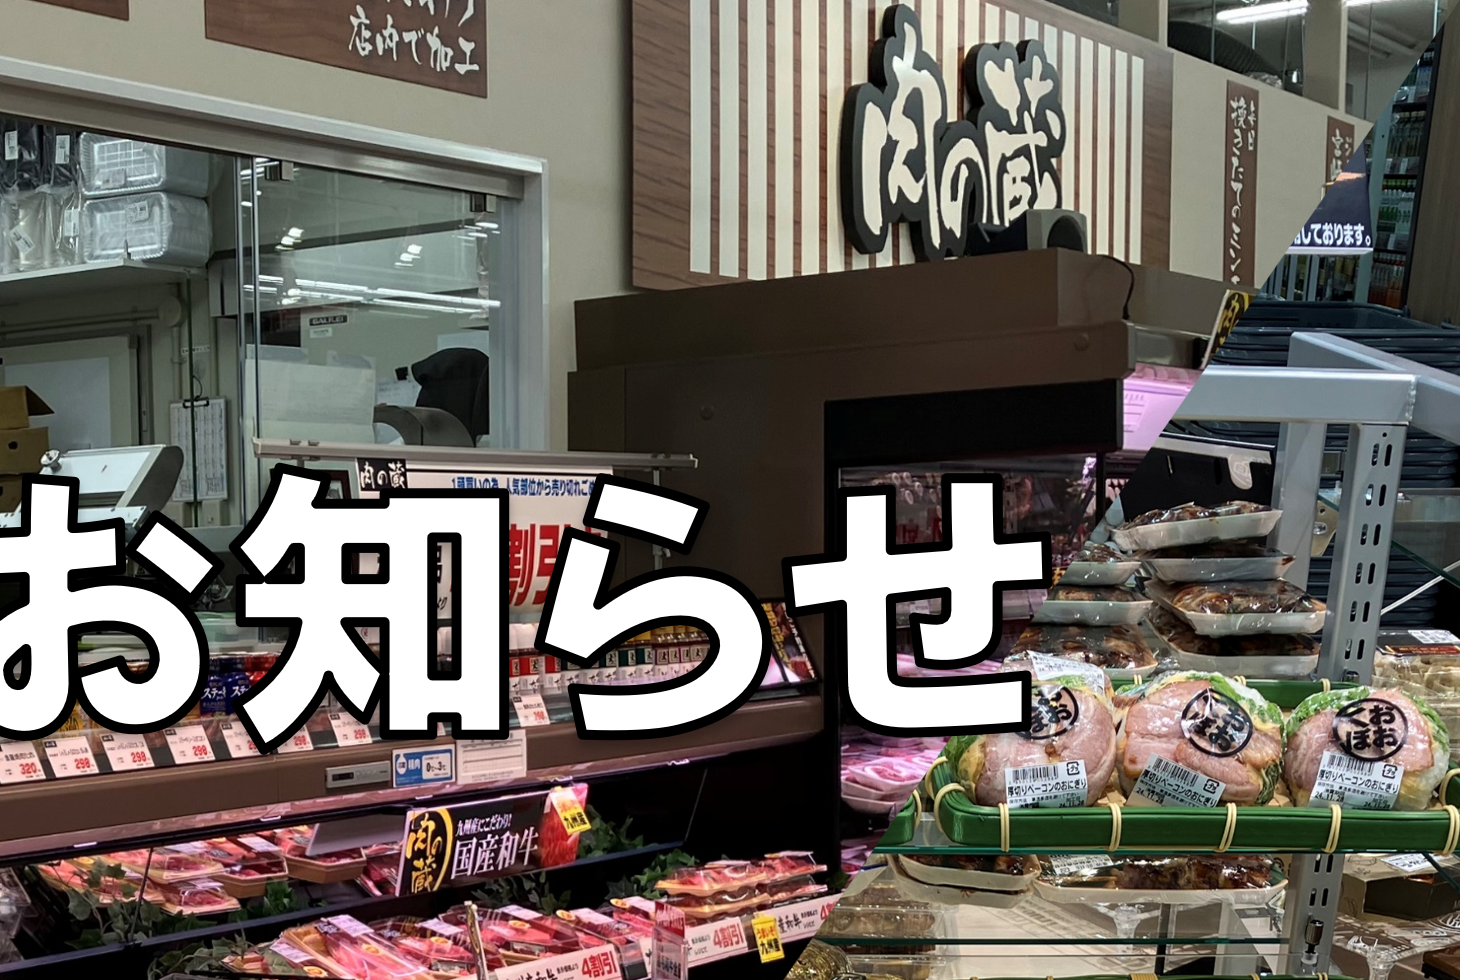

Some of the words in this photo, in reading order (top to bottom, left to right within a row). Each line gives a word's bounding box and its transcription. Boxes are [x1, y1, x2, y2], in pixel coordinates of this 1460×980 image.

[349, 4, 480, 75] 店内で加工
[852, 15, 1062, 256] 肉の蔵
[360, 461, 406, 489] 肉の蔵
[130, 752, 146, 763] 298
[193, 745, 208, 756] 298
[19, 762, 37, 775] 320
[74, 758, 90, 769] 298
[1007, 780, 1087, 797] 厚切りベーコンのおにぎり
[1142, 770, 1217, 808] 厚切りベーコンのおにぎり
[1319, 769, 1399, 794] 厚切りベーコンのおにぎり
[455, 813, 513, 837] 九州産にこだわり!
[563, 811, 588, 830] 九州産
[406, 813, 442, 894] 肉の蔵
[451, 826, 539, 880] 国産和牛
[713, 923, 744, 949] 4割引
[759, 938, 781, 956] 九州産
[581, 950, 618, 980] 4割引
